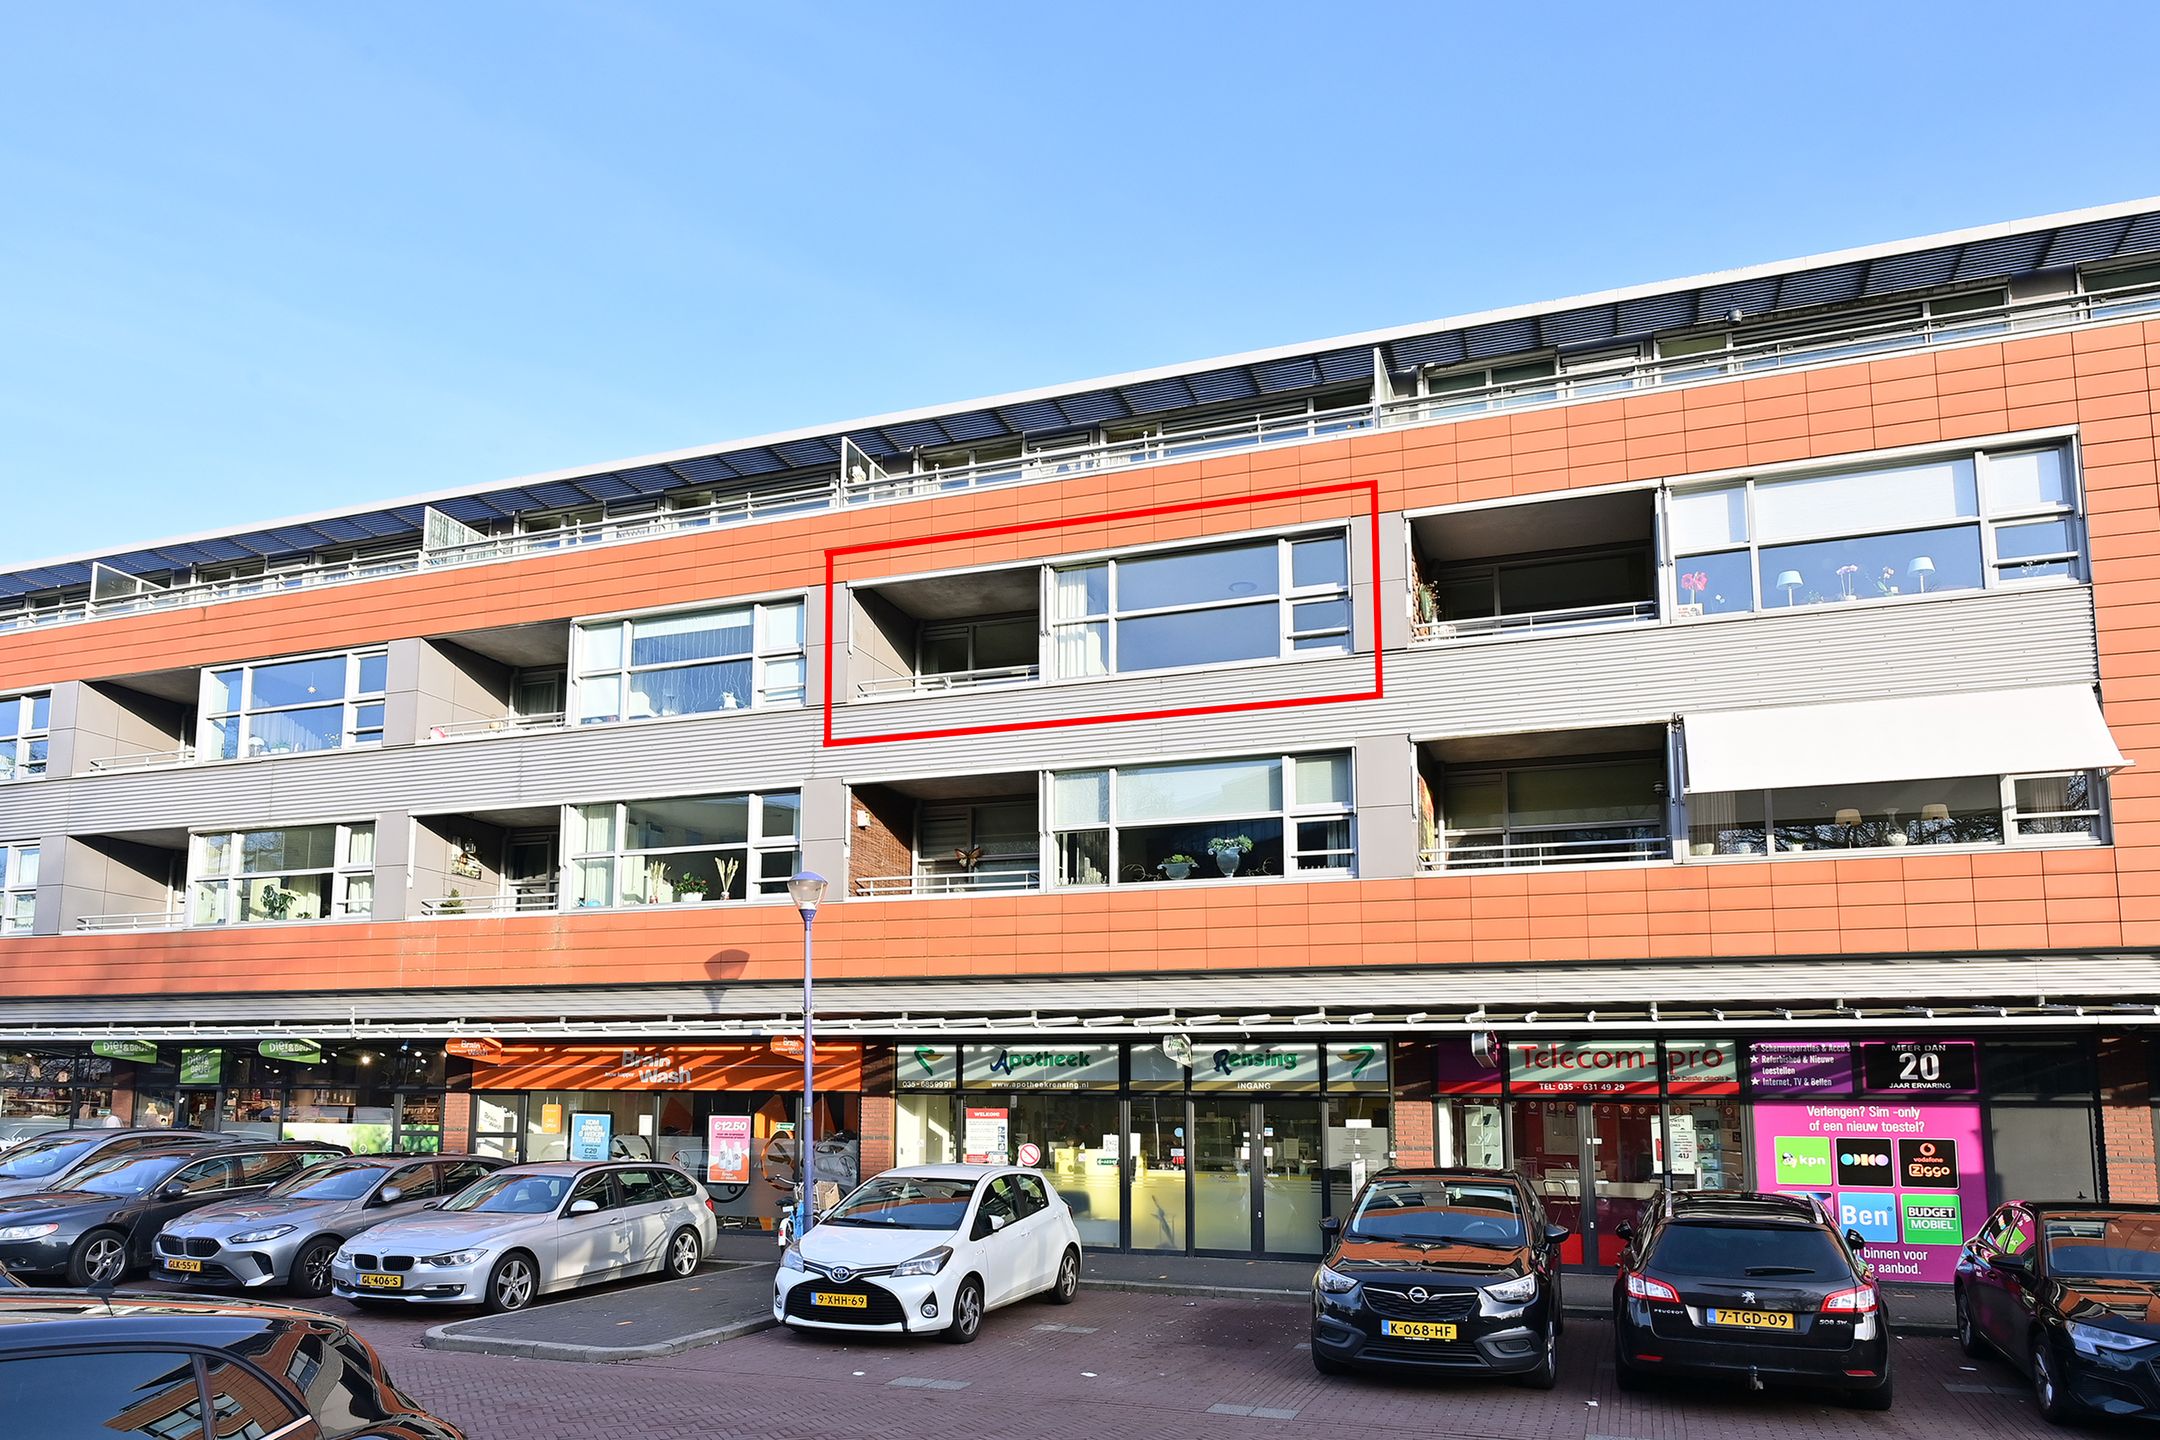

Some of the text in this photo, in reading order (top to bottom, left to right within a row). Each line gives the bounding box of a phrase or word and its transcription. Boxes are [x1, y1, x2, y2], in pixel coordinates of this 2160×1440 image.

[1760, 1043, 1852, 1053] Schermreparaties & Accu's
[622, 1050, 671, 1067] Brain
[990, 1050, 1090, 1075] Apotheek
[1213, 1049, 1297, 1075] Rensing
[1761, 1055, 1835, 1064] Refurbished & Nieuwe
[1762, 1066, 1796, 1075] toestellen
[1899, 1053, 1940, 1080] 20
[639, 1066, 692, 1083] Wash
[1237, 1082, 1271, 1090] INGANG
[1614, 1083, 1625, 1091] 29
[1762, 1078, 1833, 1087] Internet, TV & Bellen
[1807, 1105, 1920, 1120] Verlengen? Sim -only
[714, 1121, 747, 1131] €12.50
[1809, 1120, 1925, 1133] of een nieuw toestel?
[1799, 1155, 1826, 1166] kpn
[1907, 1207, 1955, 1218] BUDGET
[1910, 1219, 1954, 1230] MOBIEL
[1863, 1247, 1900, 1260] binnen
[1903, 1250, 1928, 1261] voor
[1878, 1263, 1922, 1275] aanbod.
[361, 1275, 399, 1287] GL-406-S
[818, 1294, 865, 1306] 9-XHH-69
[1719, 1310, 1788, 1326] 7-TGD-09
[1390, 1323, 1452, 1337] K-068-HF
